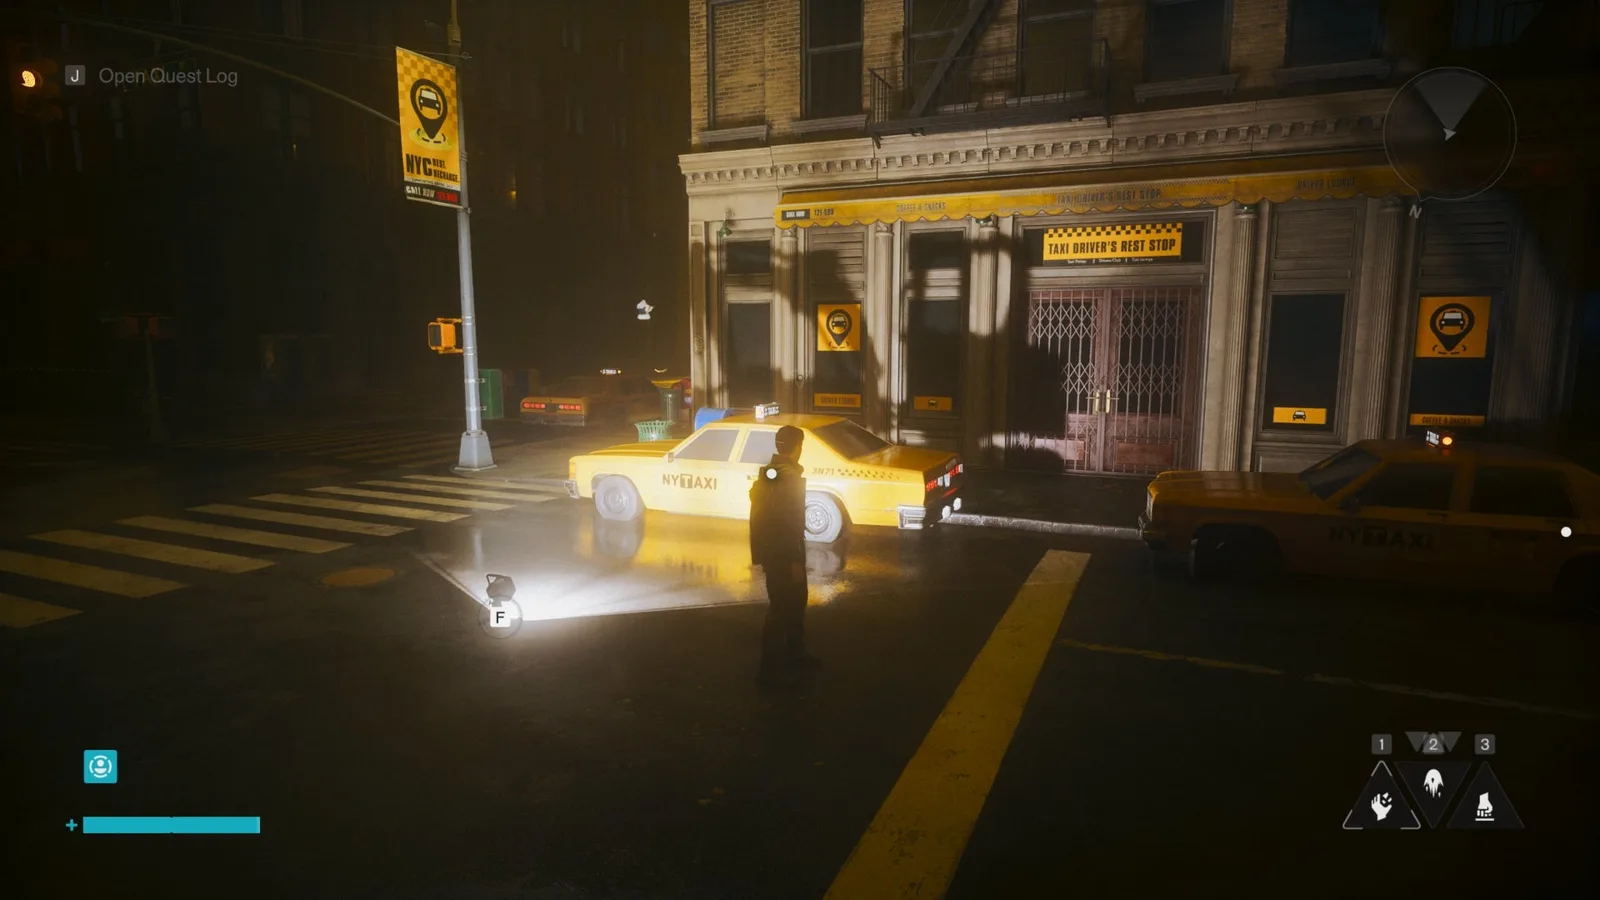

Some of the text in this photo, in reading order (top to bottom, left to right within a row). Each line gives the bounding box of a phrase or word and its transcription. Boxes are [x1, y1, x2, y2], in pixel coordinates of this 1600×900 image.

[405, 153, 432, 176] NYC
[405, 185, 421, 196] CALL
[1140, 188, 1161, 200] STOP
[1048, 238, 1176, 255] TAXI DRIVER'S REST STOP
